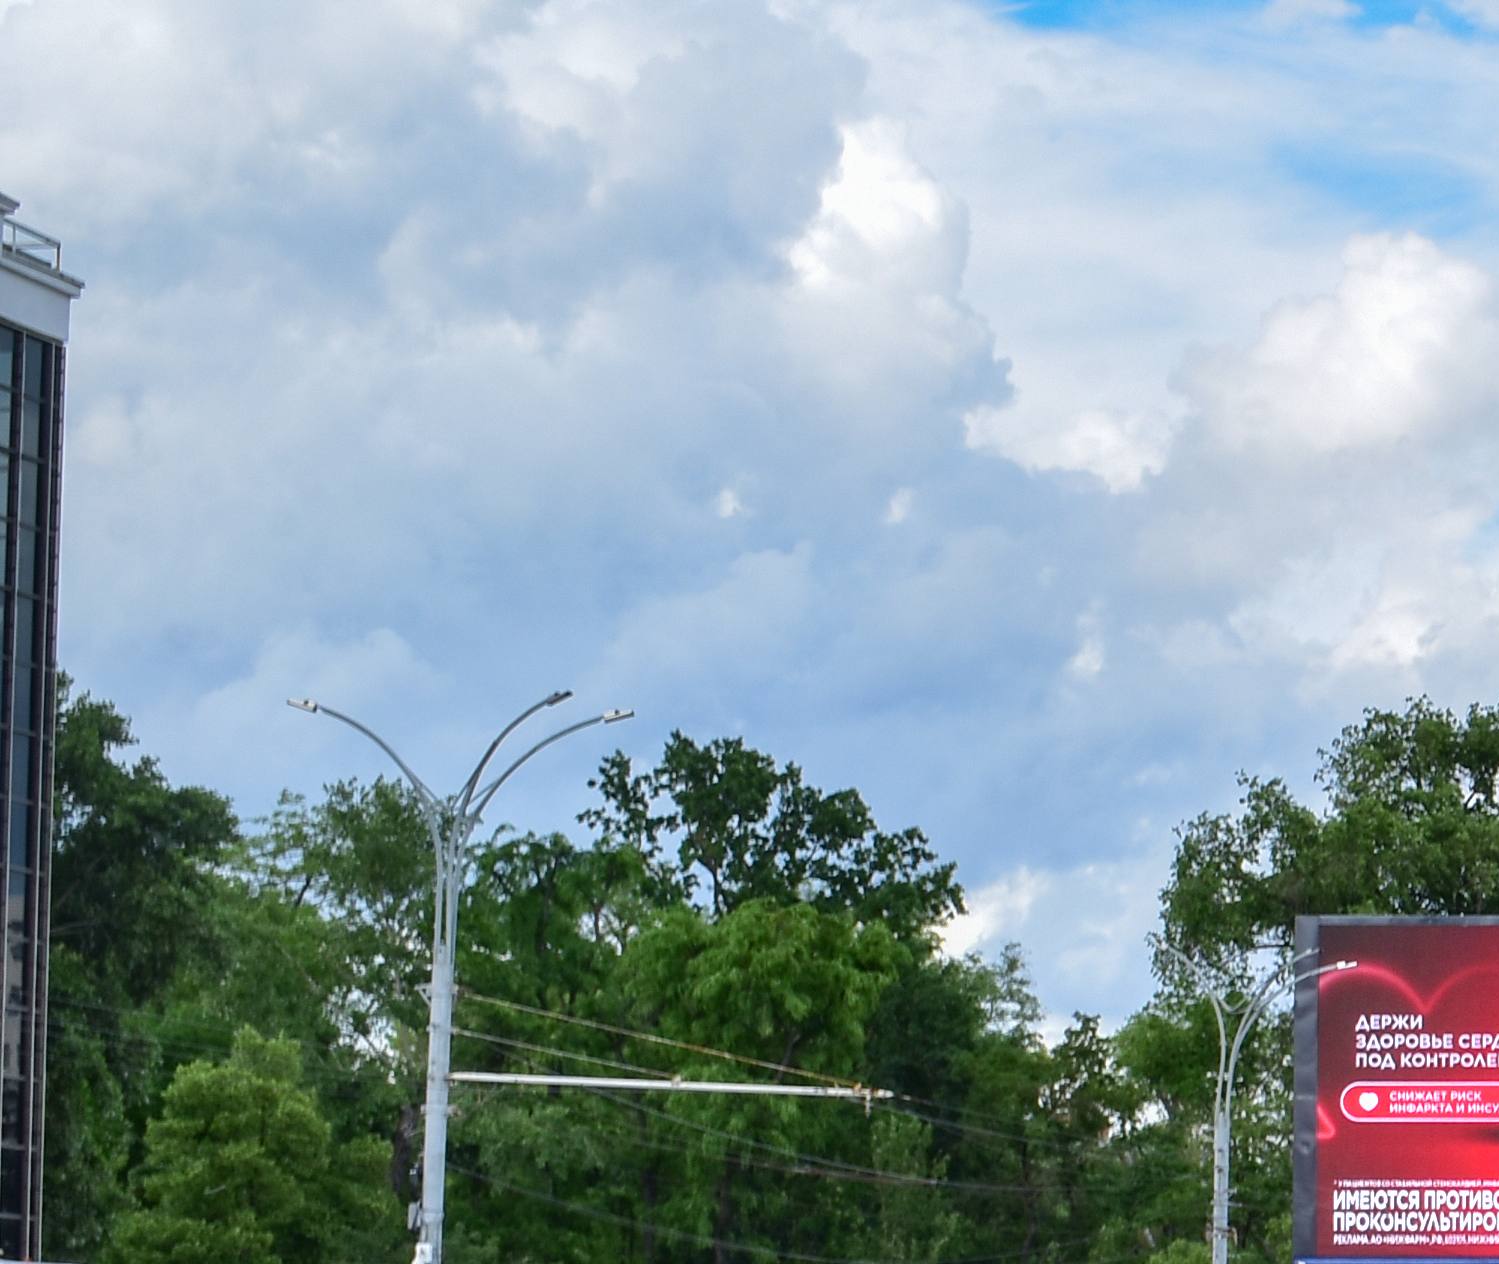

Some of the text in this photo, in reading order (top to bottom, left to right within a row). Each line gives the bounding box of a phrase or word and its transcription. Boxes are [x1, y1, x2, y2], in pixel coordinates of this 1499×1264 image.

[1355, 1014, 1423, 1032] ДЕРЖИ
[1355, 1034, 1454, 1051] ЗДОРОВЬЕ
[1355, 1053, 1396, 1070] ПОД
[1389, 1090, 1482, 1101] СНИЖАЕТ РИСК
[1389, 1103, 1453, 1114] ИНФАРКТА
[1456, 1103, 1465, 1113] И
[1333, 1189, 1420, 1210] ИМЕЮТСЯ
